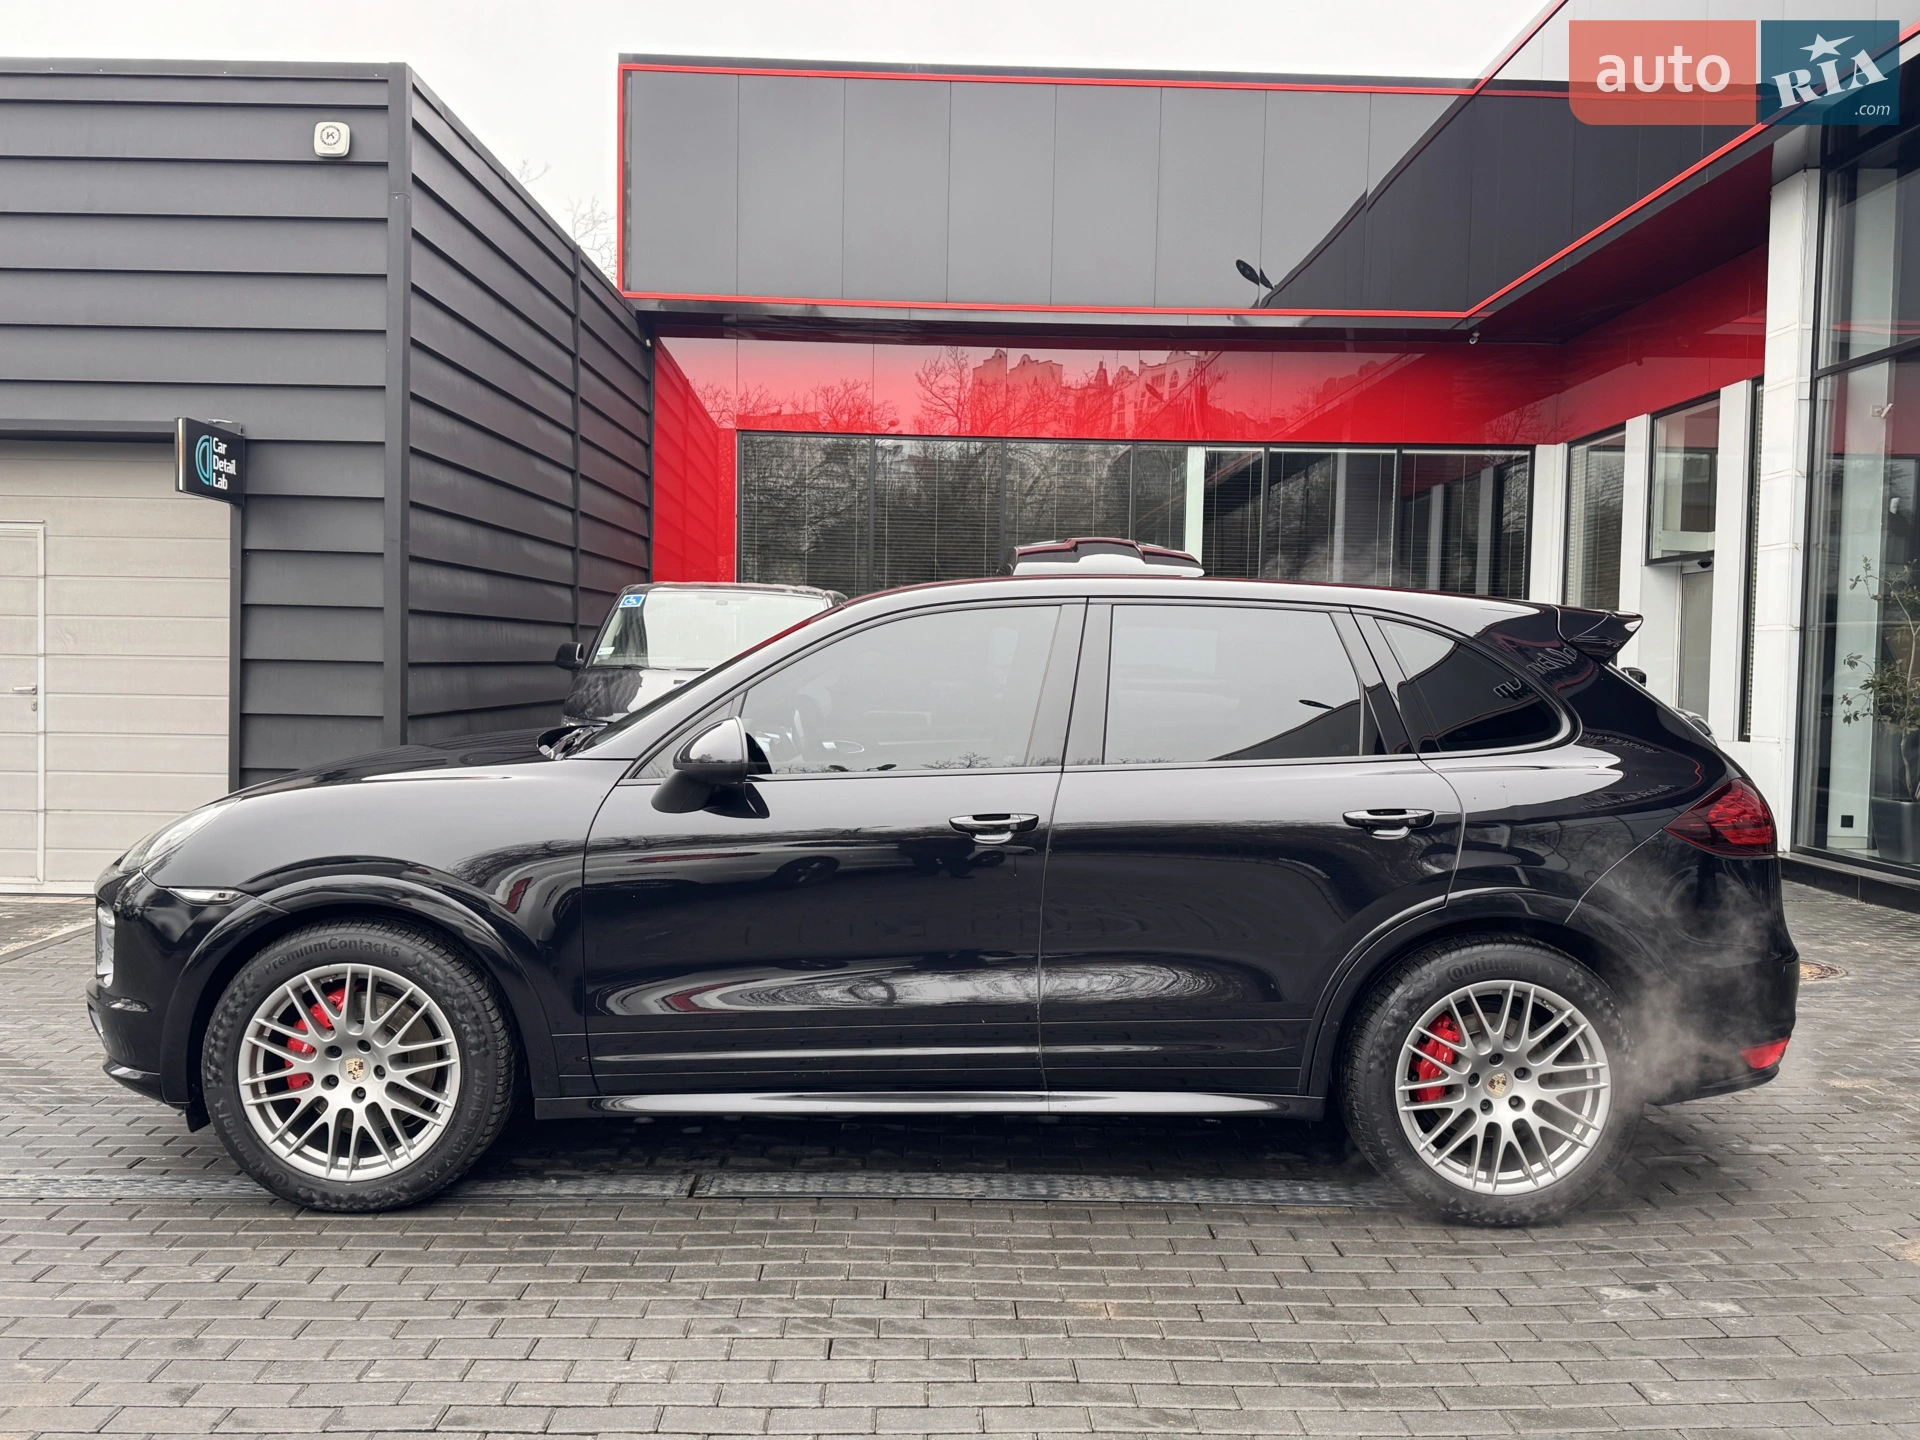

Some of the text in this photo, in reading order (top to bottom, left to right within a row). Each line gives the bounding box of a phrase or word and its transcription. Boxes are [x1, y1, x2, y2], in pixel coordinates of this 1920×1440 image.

[212, 437, 228, 455] Car
[212, 454, 237, 475] Detail
[212, 472, 228, 490] Lab
[263, 937, 389, 975] PremiumContact
